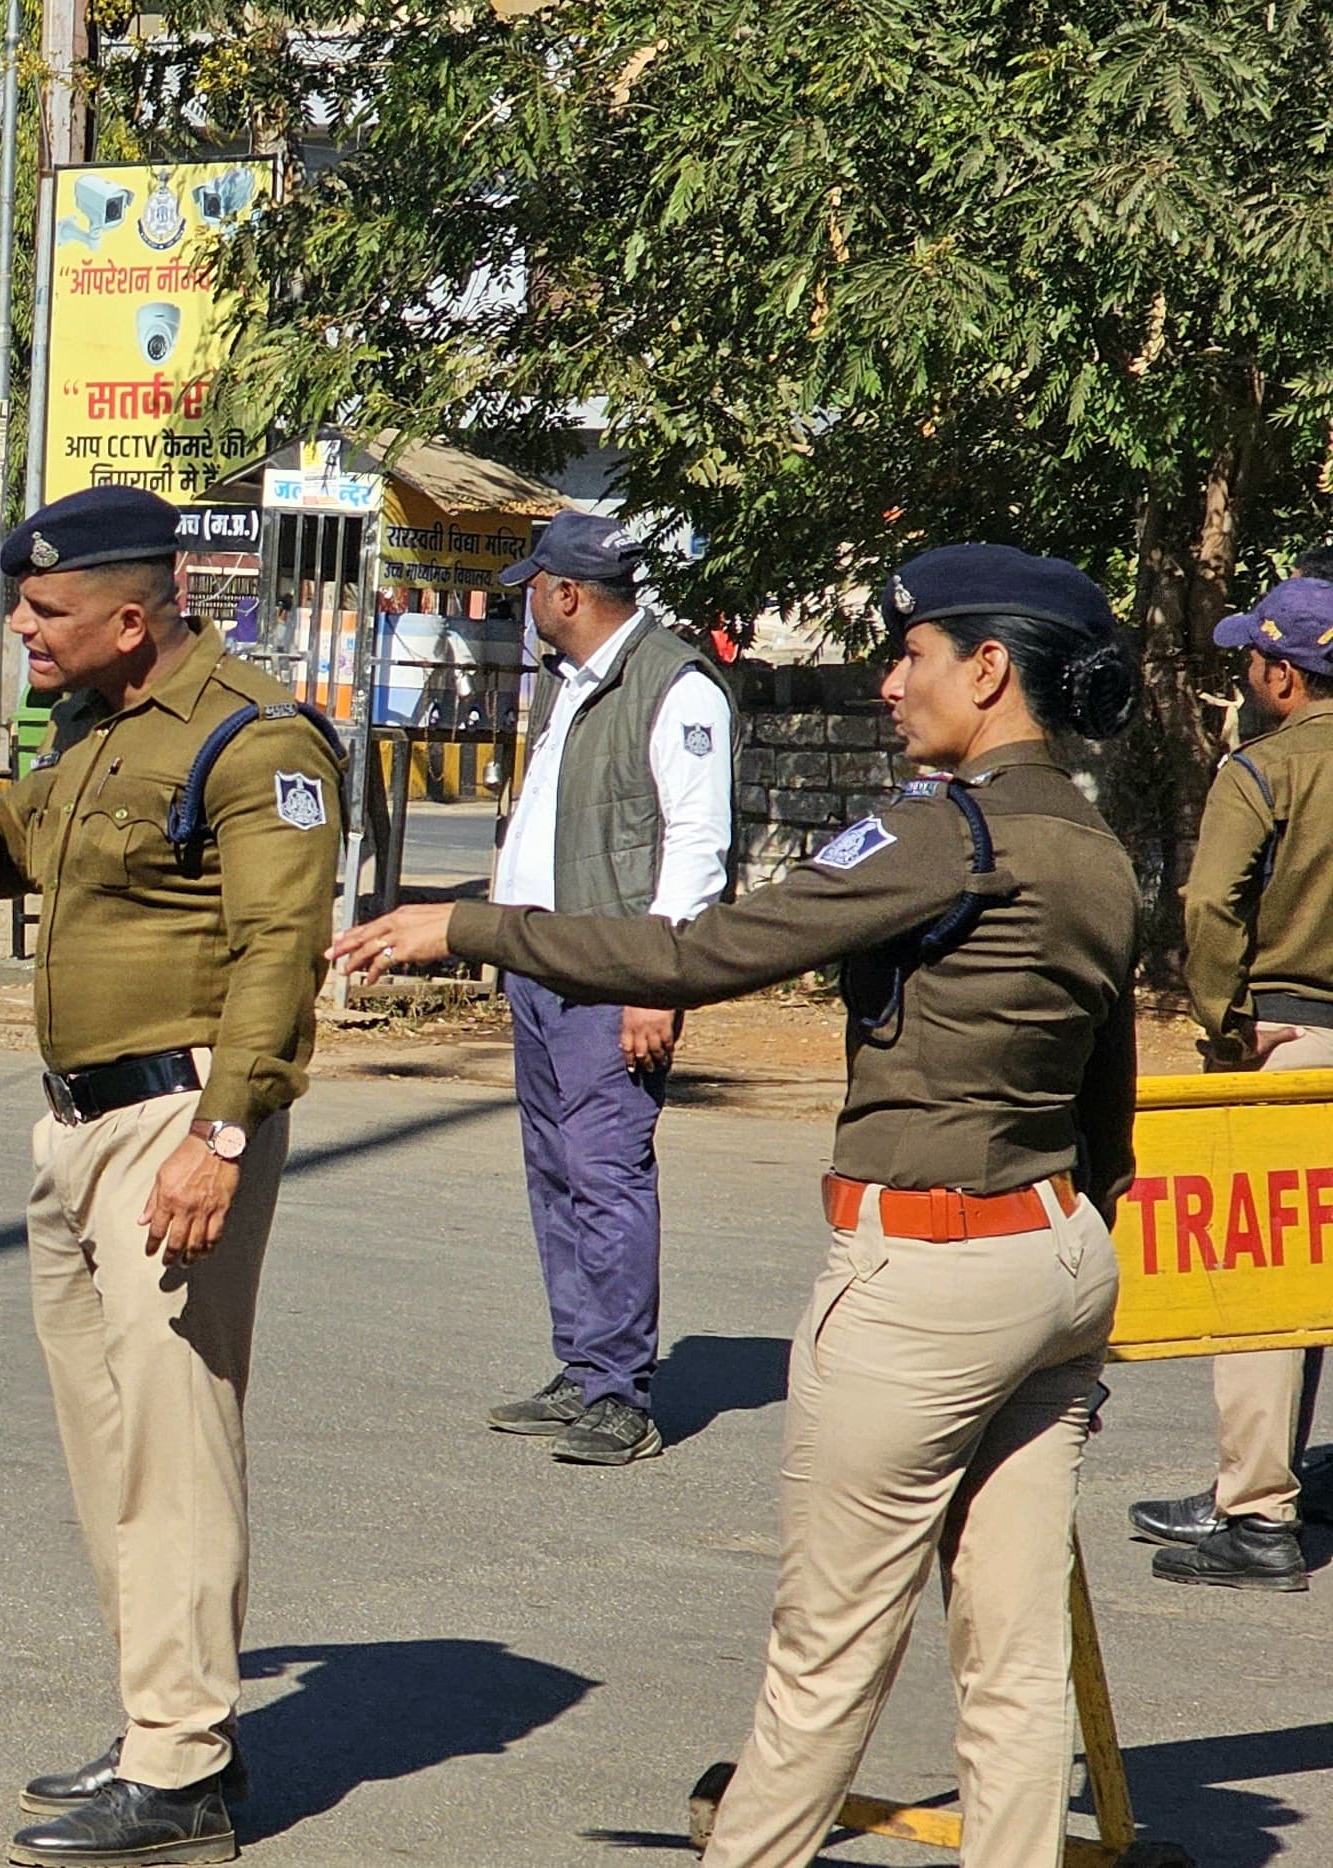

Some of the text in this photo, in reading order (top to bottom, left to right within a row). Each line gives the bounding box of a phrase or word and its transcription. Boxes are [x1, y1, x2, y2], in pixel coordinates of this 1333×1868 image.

[86, 372, 173, 420] सतर्क
[65, 428, 246, 459] आप CCTV कैमरे की
[386, 521, 528, 559] सरस्वती विद्या मन्दिर
[384, 561, 404, 579] उच्च
[406, 559, 451, 583] माध्यमिक
